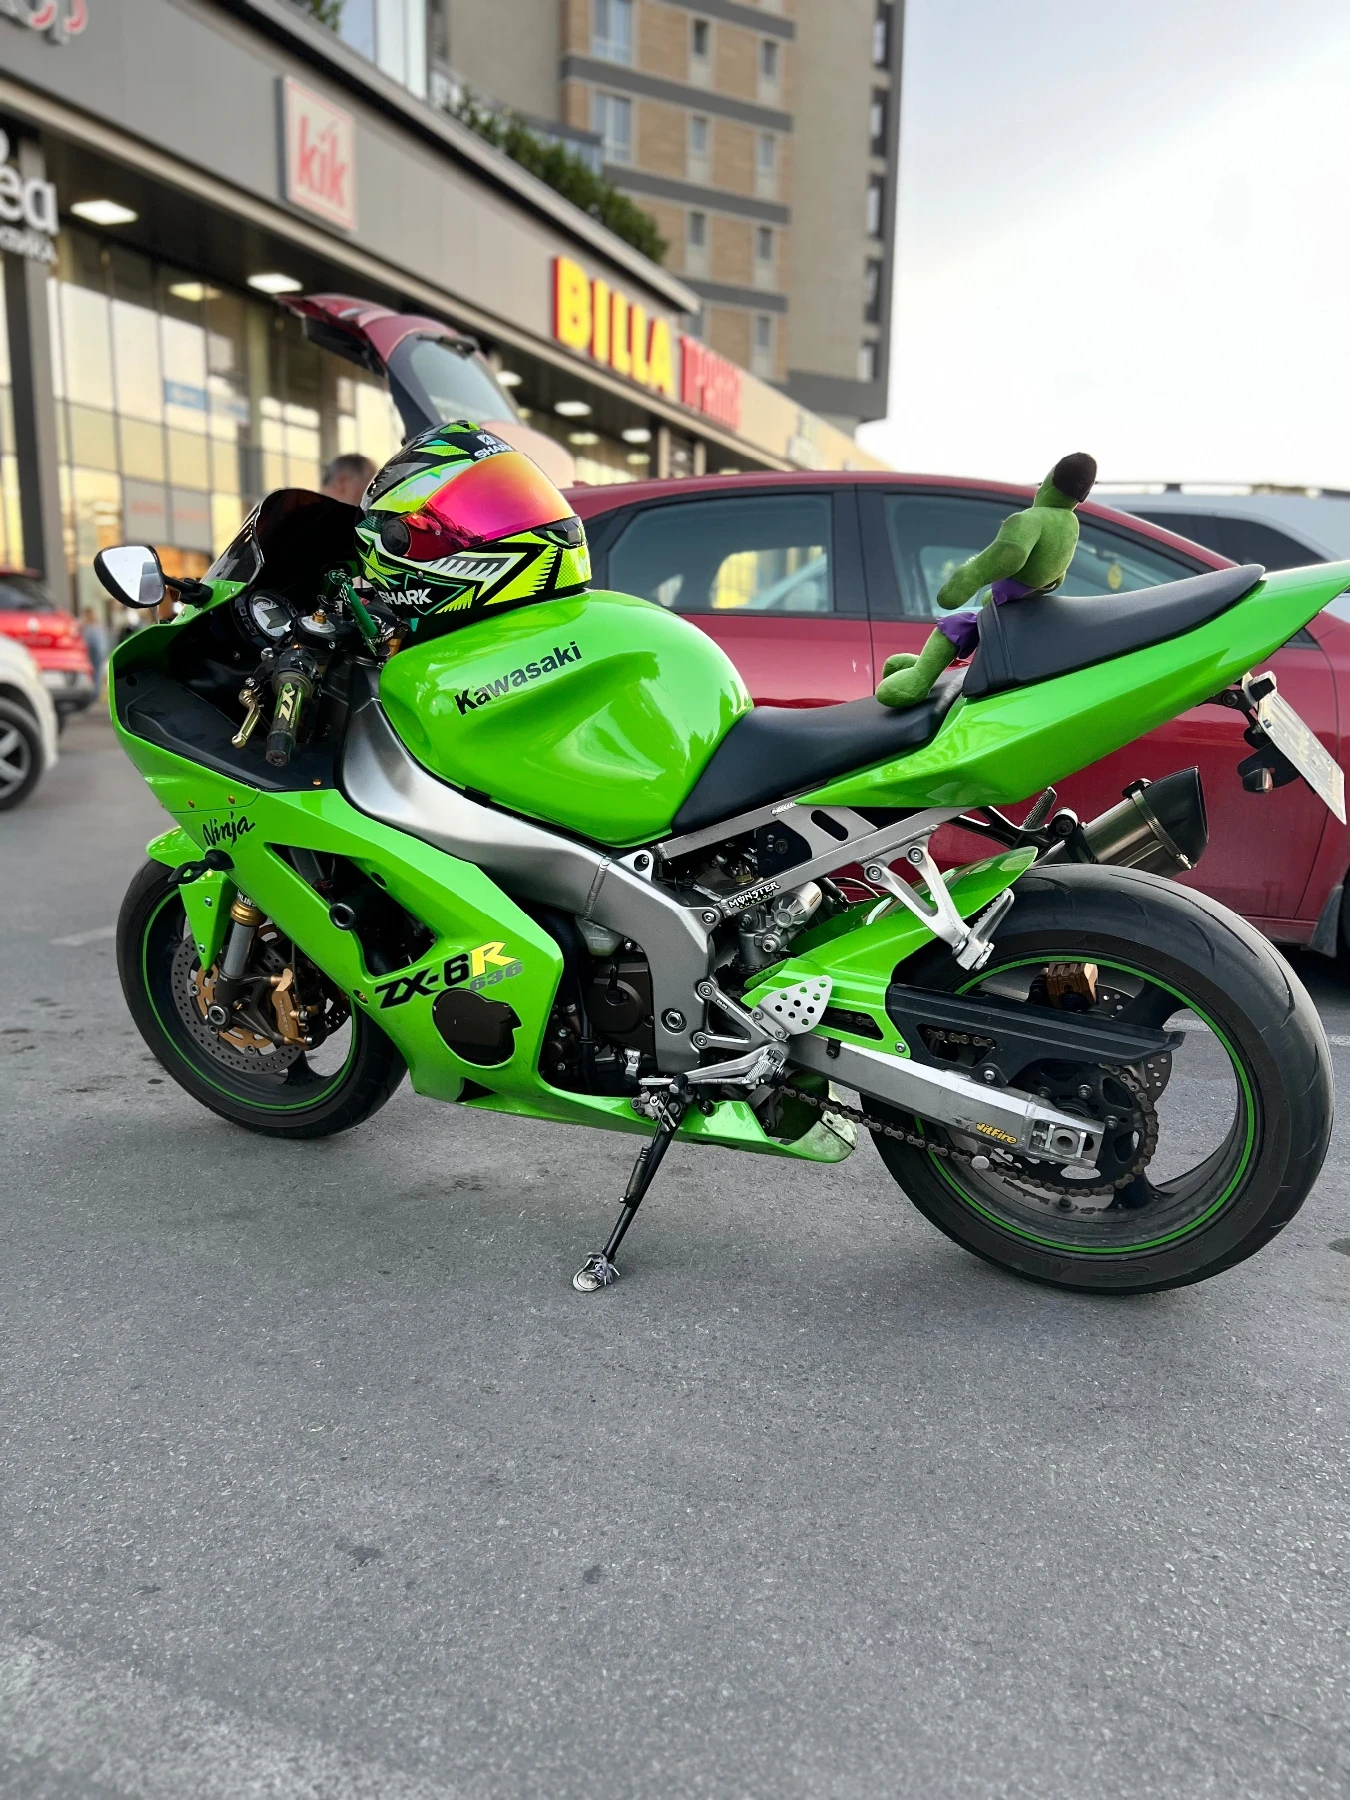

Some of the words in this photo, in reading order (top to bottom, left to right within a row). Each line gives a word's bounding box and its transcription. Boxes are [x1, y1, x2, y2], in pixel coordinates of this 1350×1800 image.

[552, 256, 674, 397] BILLA
[473, 444, 513, 459] SHARK
[378, 588, 433, 606] SHARK
[454, 641, 582, 716] Kawasaki
[202, 811, 256, 848] Ninja
[728, 881, 780, 908] MONSTER
[374, 940, 520, 1009] ZX-6R
[469, 961, 523, 991] 636
